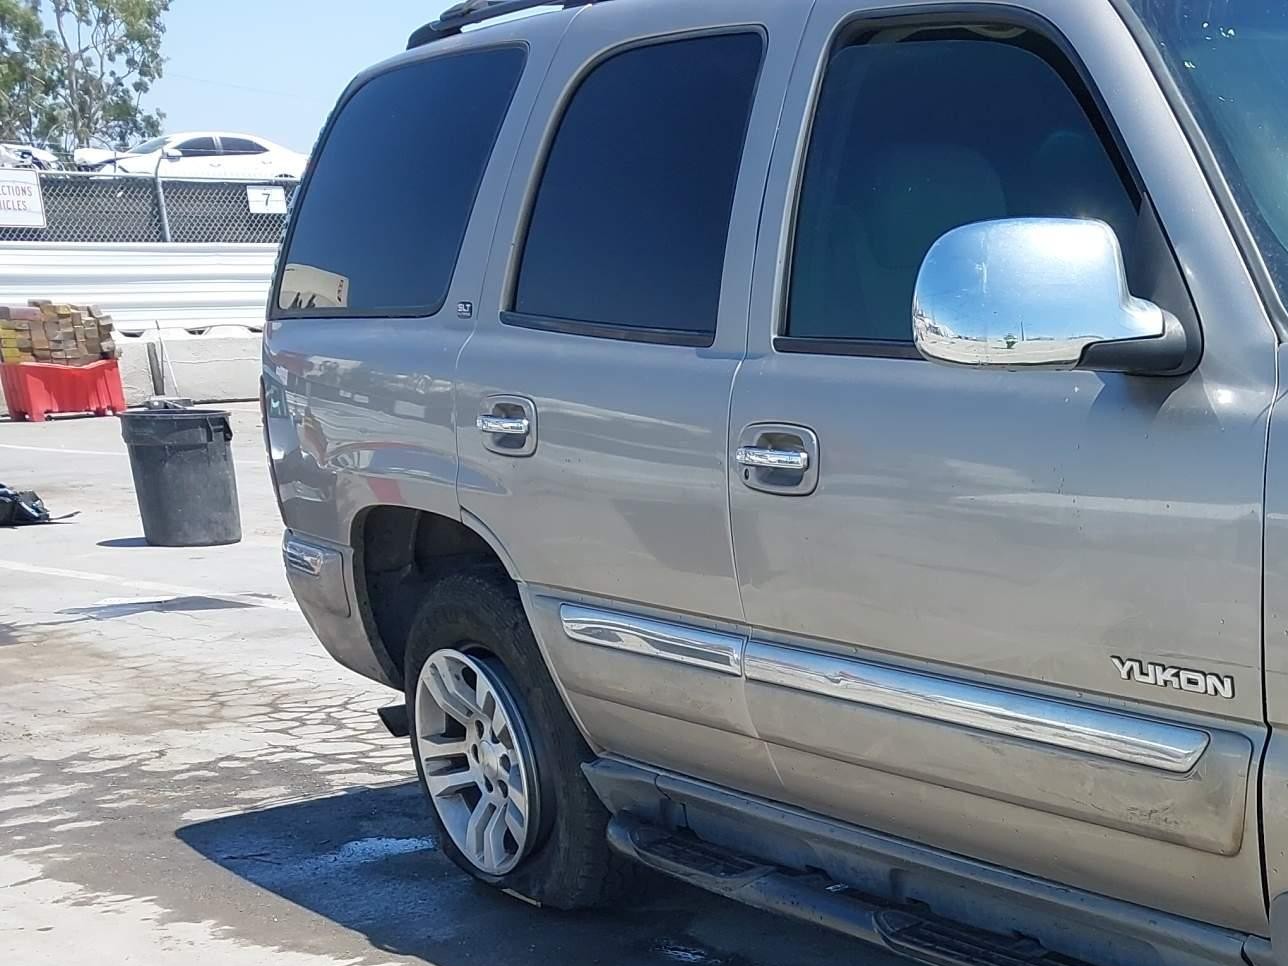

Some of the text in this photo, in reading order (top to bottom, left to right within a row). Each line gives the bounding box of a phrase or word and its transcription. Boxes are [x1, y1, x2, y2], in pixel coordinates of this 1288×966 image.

[0, 185, 33, 197] CTIONS
[261, 192, 271, 206] 7
[1110, 655, 1235, 699] YUKON
